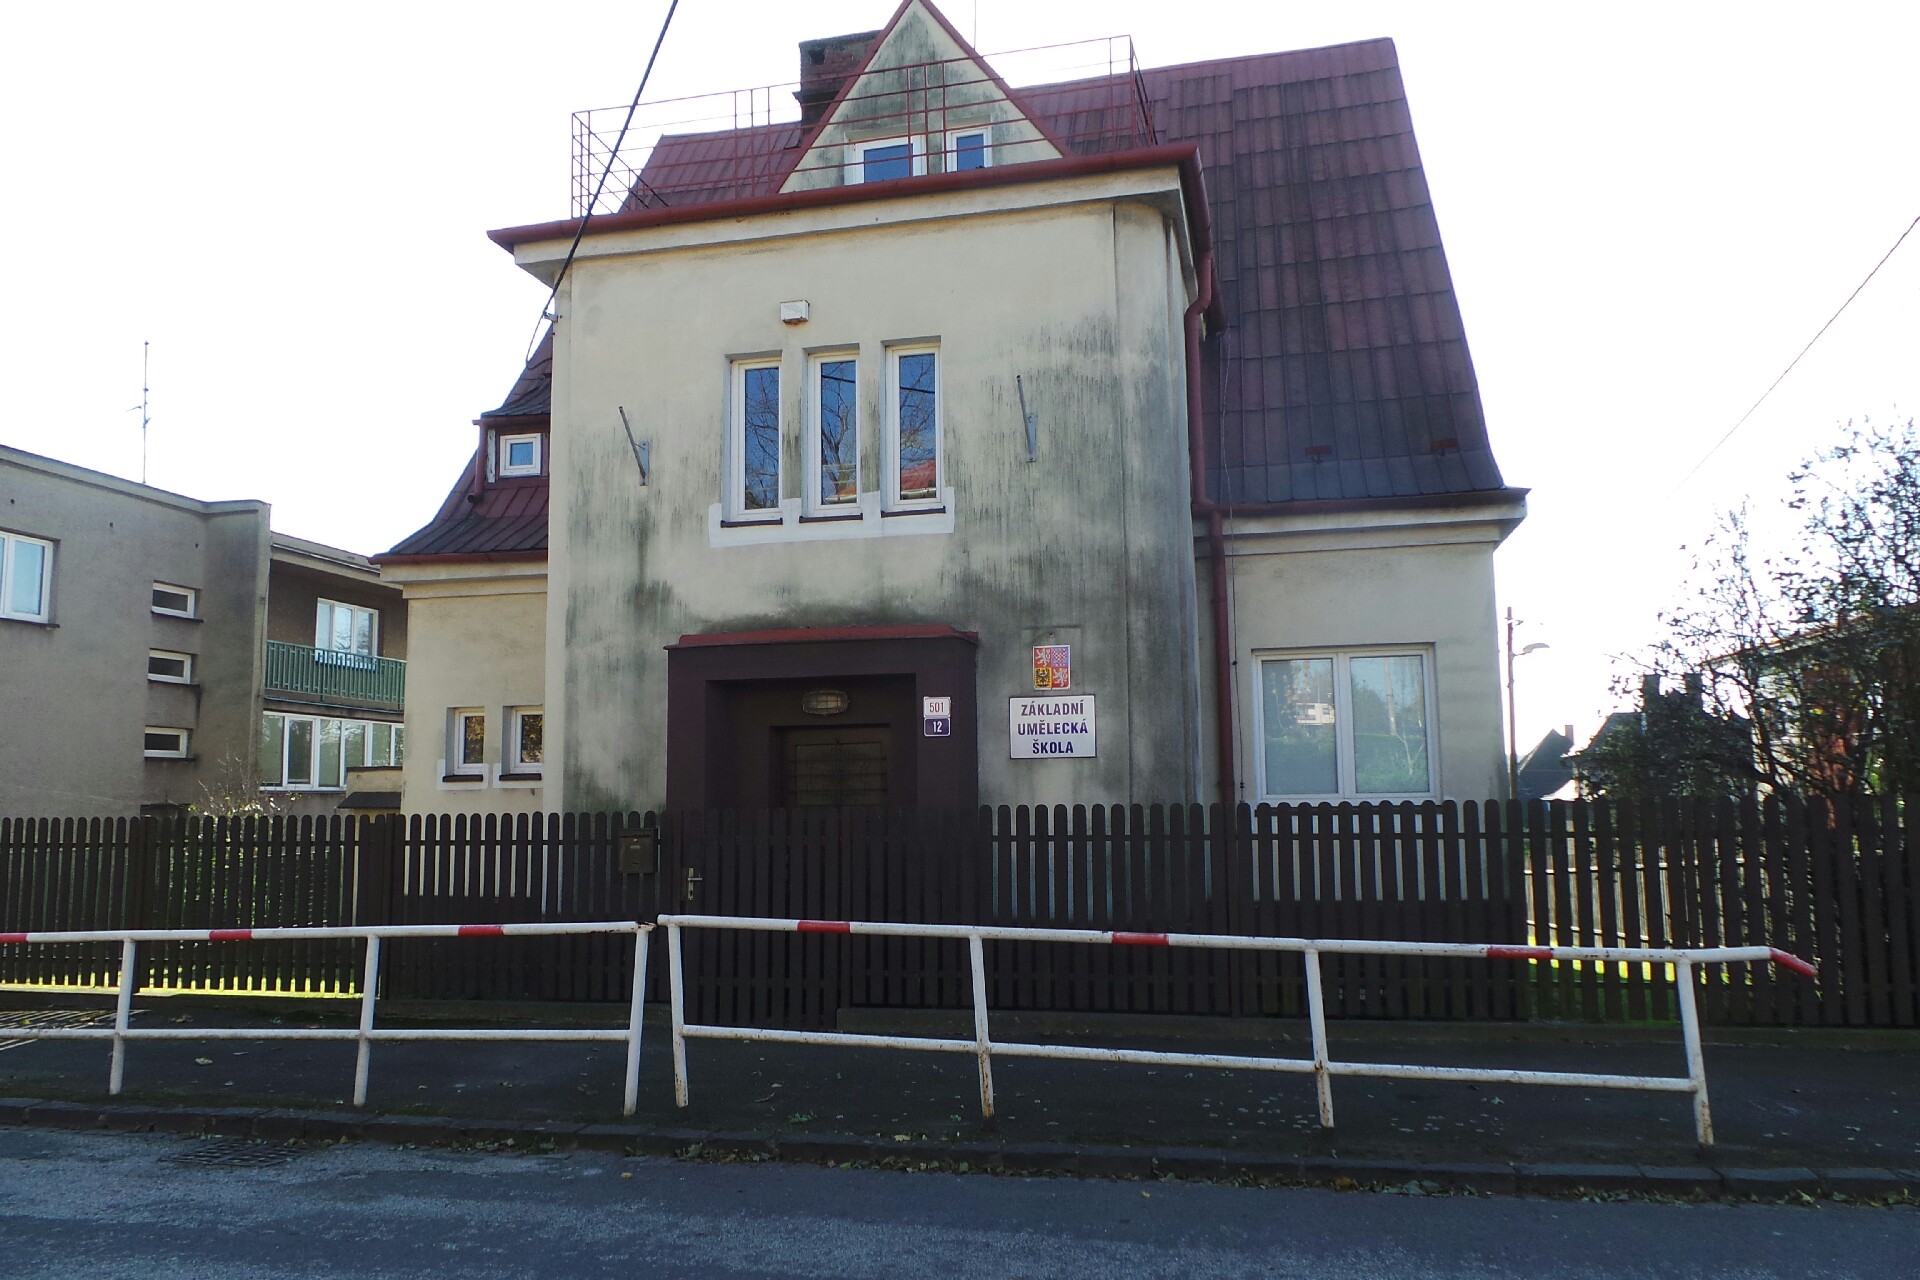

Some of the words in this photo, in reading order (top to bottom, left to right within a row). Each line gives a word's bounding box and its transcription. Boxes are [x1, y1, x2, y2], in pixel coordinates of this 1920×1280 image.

[929, 702, 944, 713] 501
[1020, 700, 1084, 716] ZÁKLADNÍ
[932, 721, 943, 733] 12
[1017, 718, 1088, 736] UMĚLECKÁ
[1032, 739, 1074, 754] ŠKOLA
